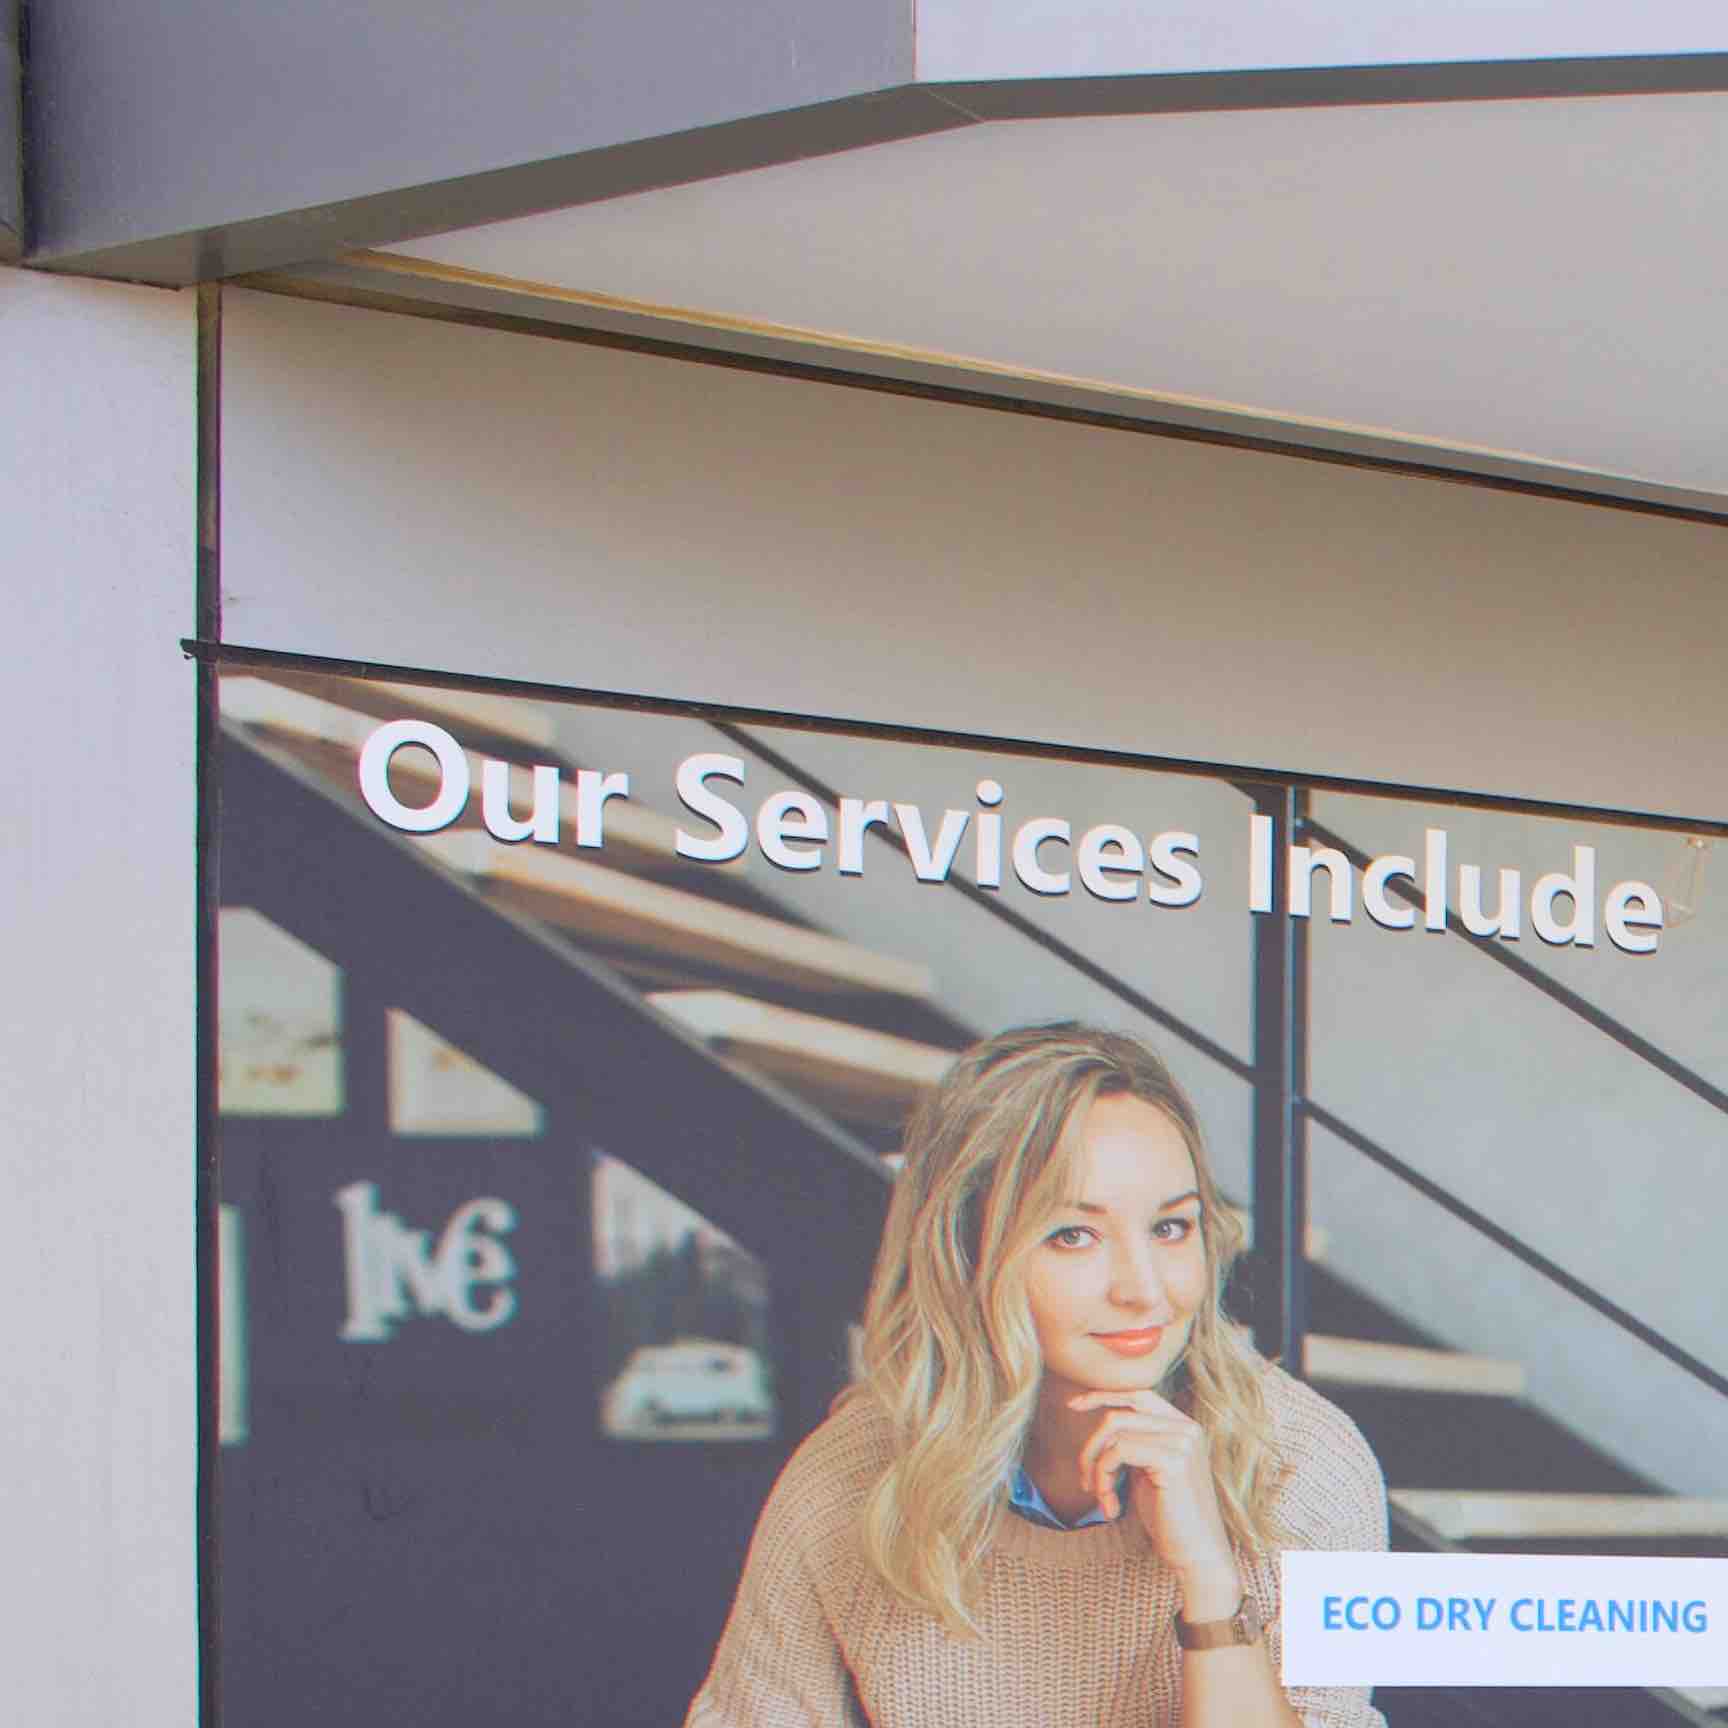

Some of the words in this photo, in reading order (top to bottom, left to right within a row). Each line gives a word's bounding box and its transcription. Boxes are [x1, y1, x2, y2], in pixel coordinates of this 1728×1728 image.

[358, 718, 629, 850] Our
[673, 751, 1203, 910] Services
[1247, 811, 1666, 954] Include
[1322, 1595, 1401, 1632] ECO
[1416, 1597, 1497, 1632] DRY
[1508, 1598, 1709, 1634] CLEANING
